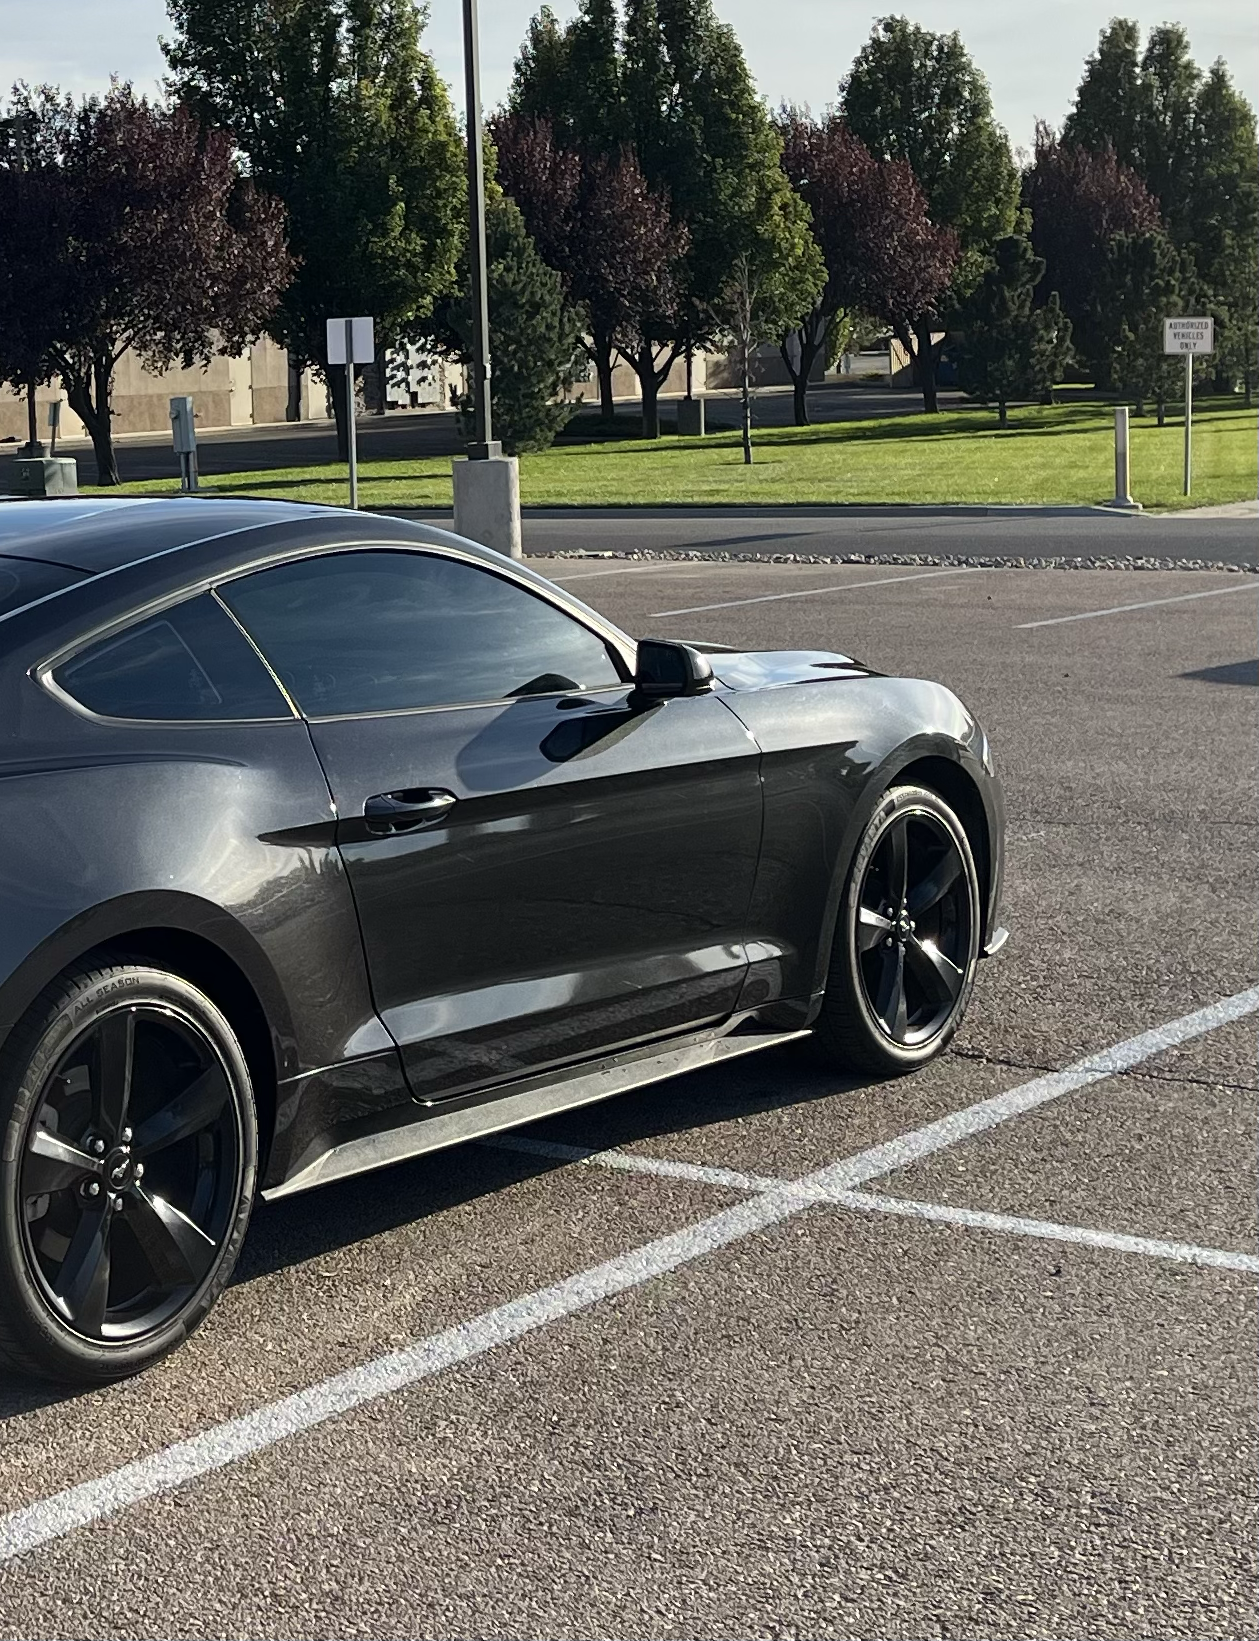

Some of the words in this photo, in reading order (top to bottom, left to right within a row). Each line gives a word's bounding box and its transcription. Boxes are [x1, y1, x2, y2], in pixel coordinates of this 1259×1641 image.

[1169, 321, 1209, 329] AUTHORIZED
[1173, 332, 1204, 340] VEHICLES
[1179, 342, 1198, 350] ONLY
[74, 997, 94, 1015] ALL
[95, 977, 140, 998] SEASON
